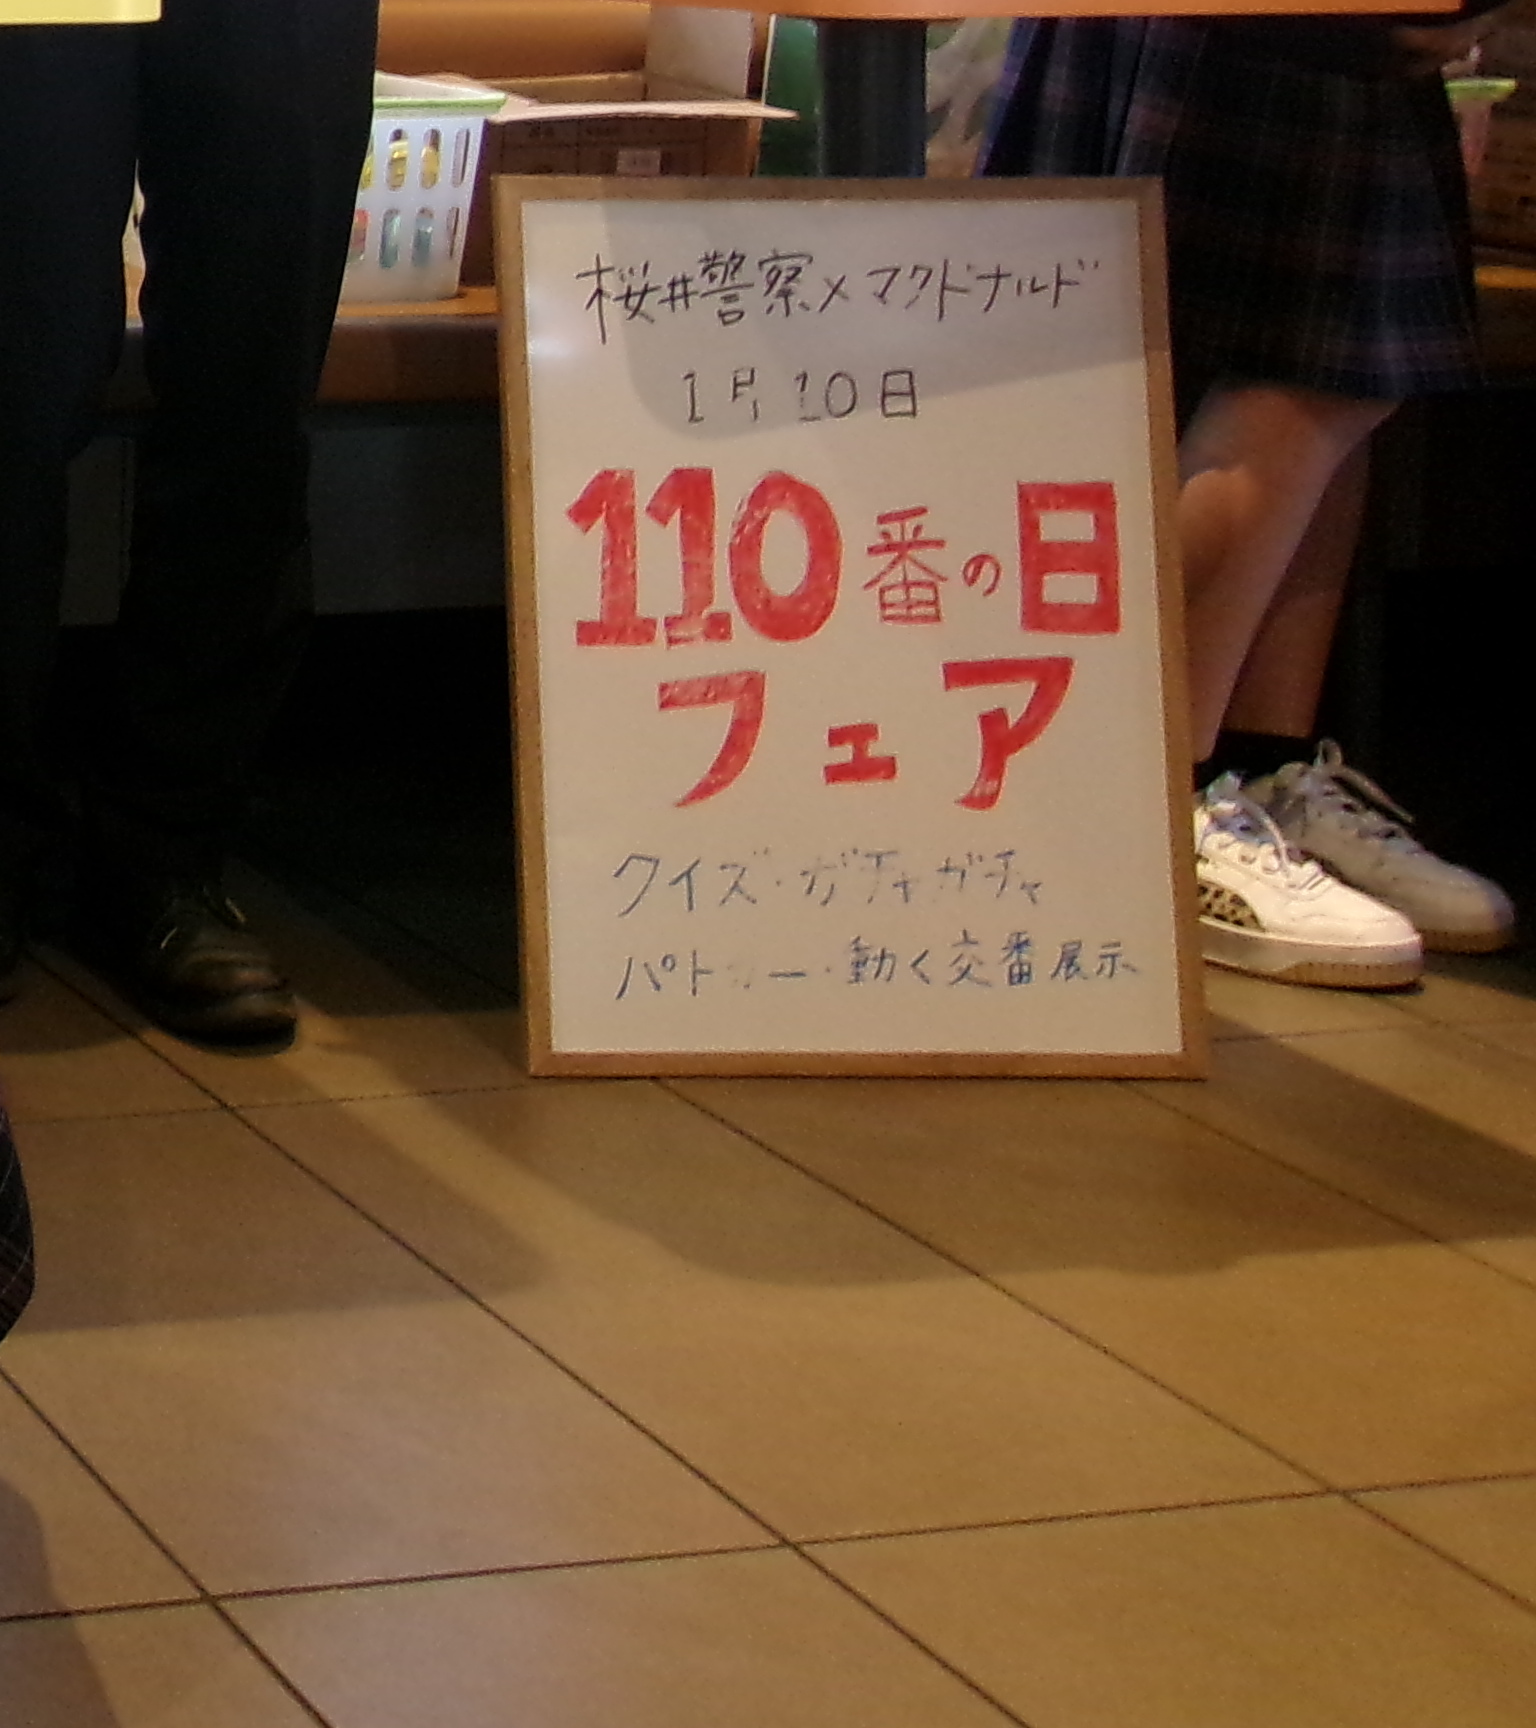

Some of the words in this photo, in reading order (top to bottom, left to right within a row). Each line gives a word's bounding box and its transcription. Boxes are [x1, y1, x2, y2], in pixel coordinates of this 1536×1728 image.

[565, 466, 1121, 650] 110番の日
[657, 656, 1074, 809] フェア
[613, 928, 1138, 1001] パトー・動く交番展示
